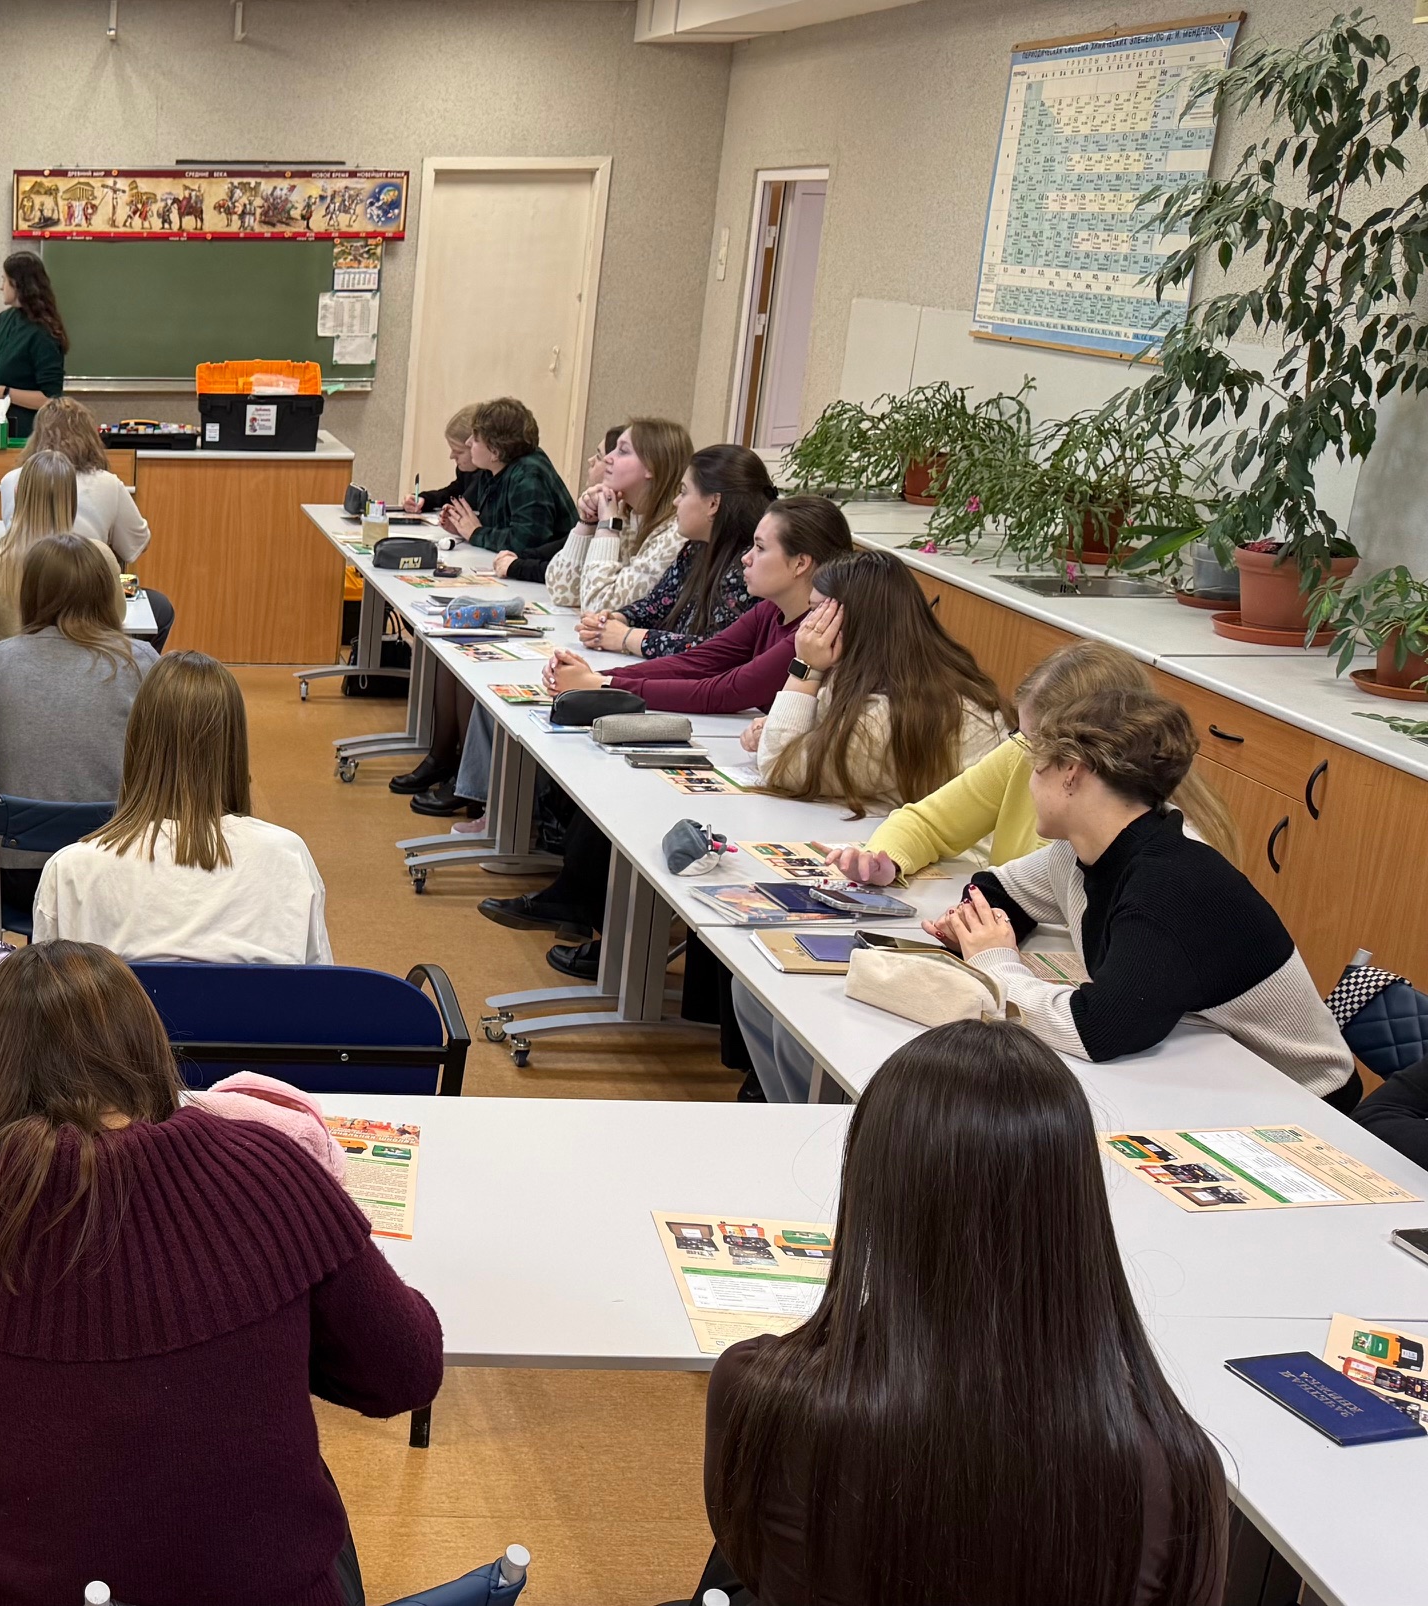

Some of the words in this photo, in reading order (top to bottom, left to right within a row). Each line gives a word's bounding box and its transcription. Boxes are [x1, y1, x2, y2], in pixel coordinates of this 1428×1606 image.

[1066, 56, 1099, 67] ГРУППЫ
[1105, 49, 1164, 63] ЭЛЕМЕНТОВ
[1278, 1370, 1354, 1418] ЗАЧЕТНАЯ
[1299, 1371, 1365, 1413] КНИЖКА
